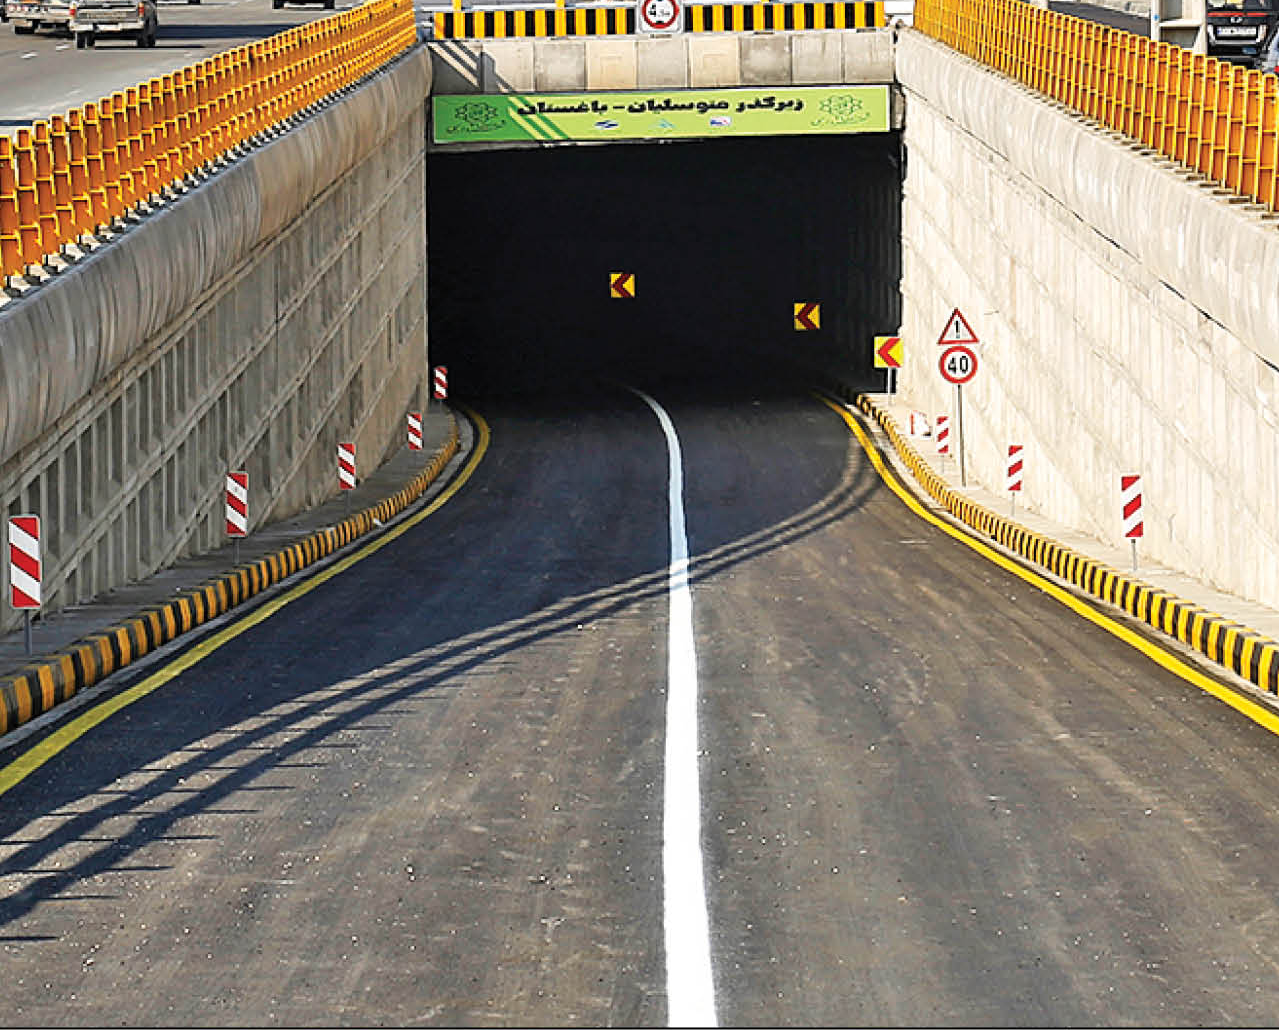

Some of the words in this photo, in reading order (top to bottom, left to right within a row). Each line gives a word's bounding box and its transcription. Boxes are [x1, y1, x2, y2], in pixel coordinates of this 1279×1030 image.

[516, 100, 608, 117] باغستان
[735, 96, 804, 113] زیرگذر
[947, 355, 969, 374] 40
